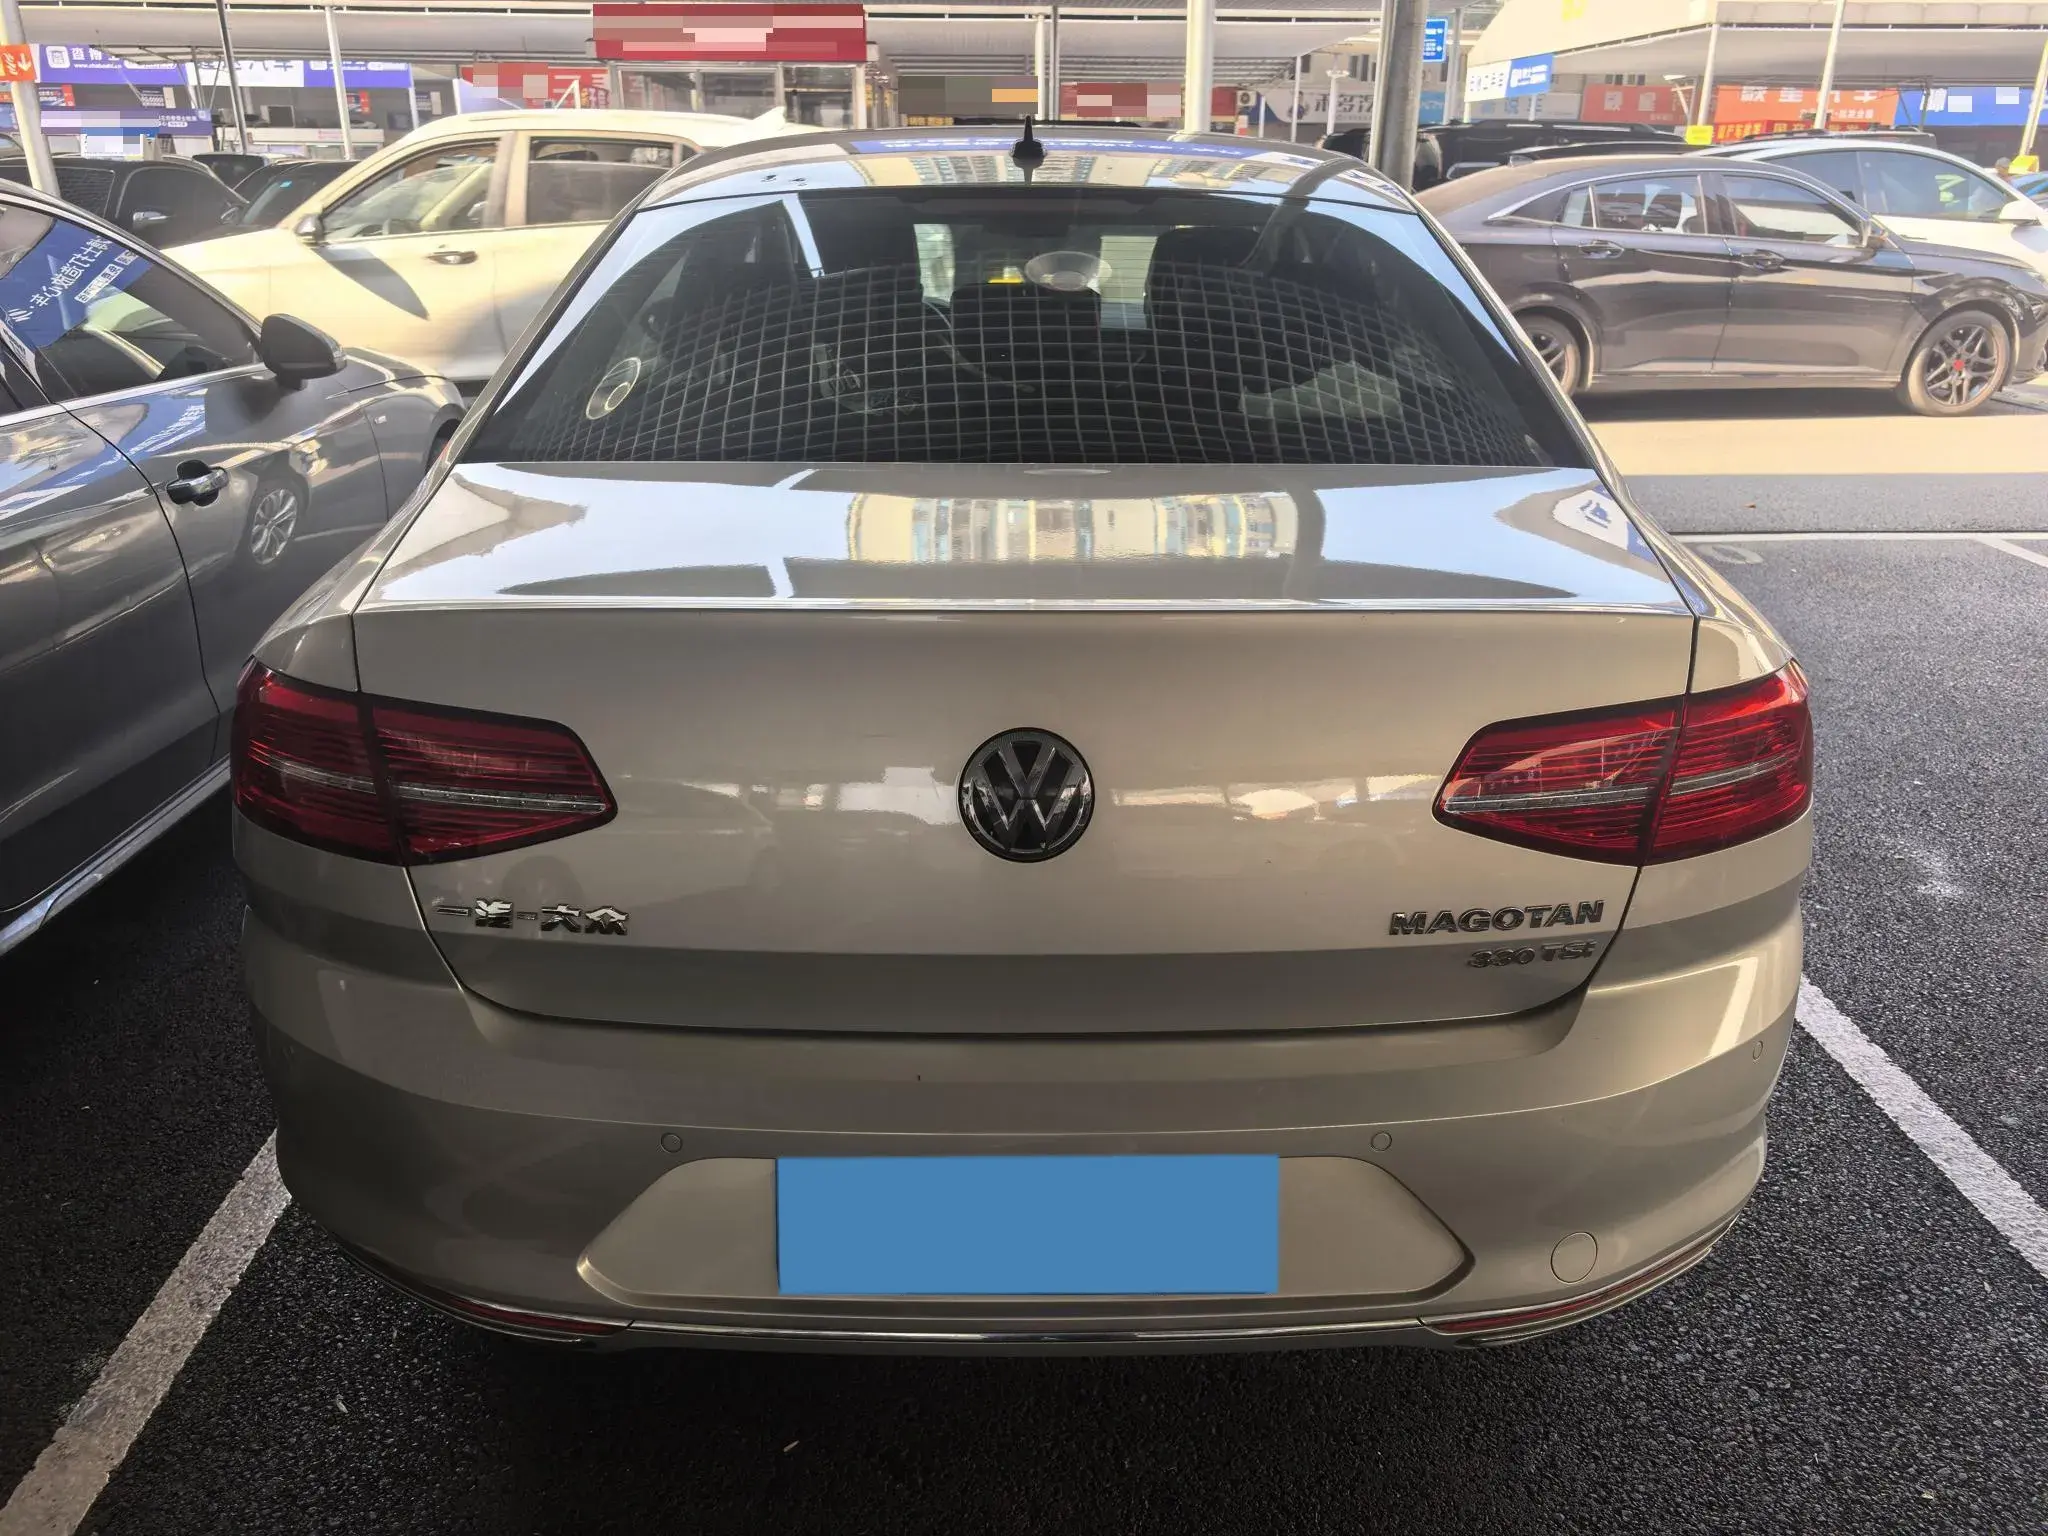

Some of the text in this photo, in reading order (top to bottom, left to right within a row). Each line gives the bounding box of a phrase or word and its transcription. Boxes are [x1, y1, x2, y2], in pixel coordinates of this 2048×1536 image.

[434, 897, 630, 936] 一汽-大众
[1388, 899, 1605, 936] MAGOTAN
